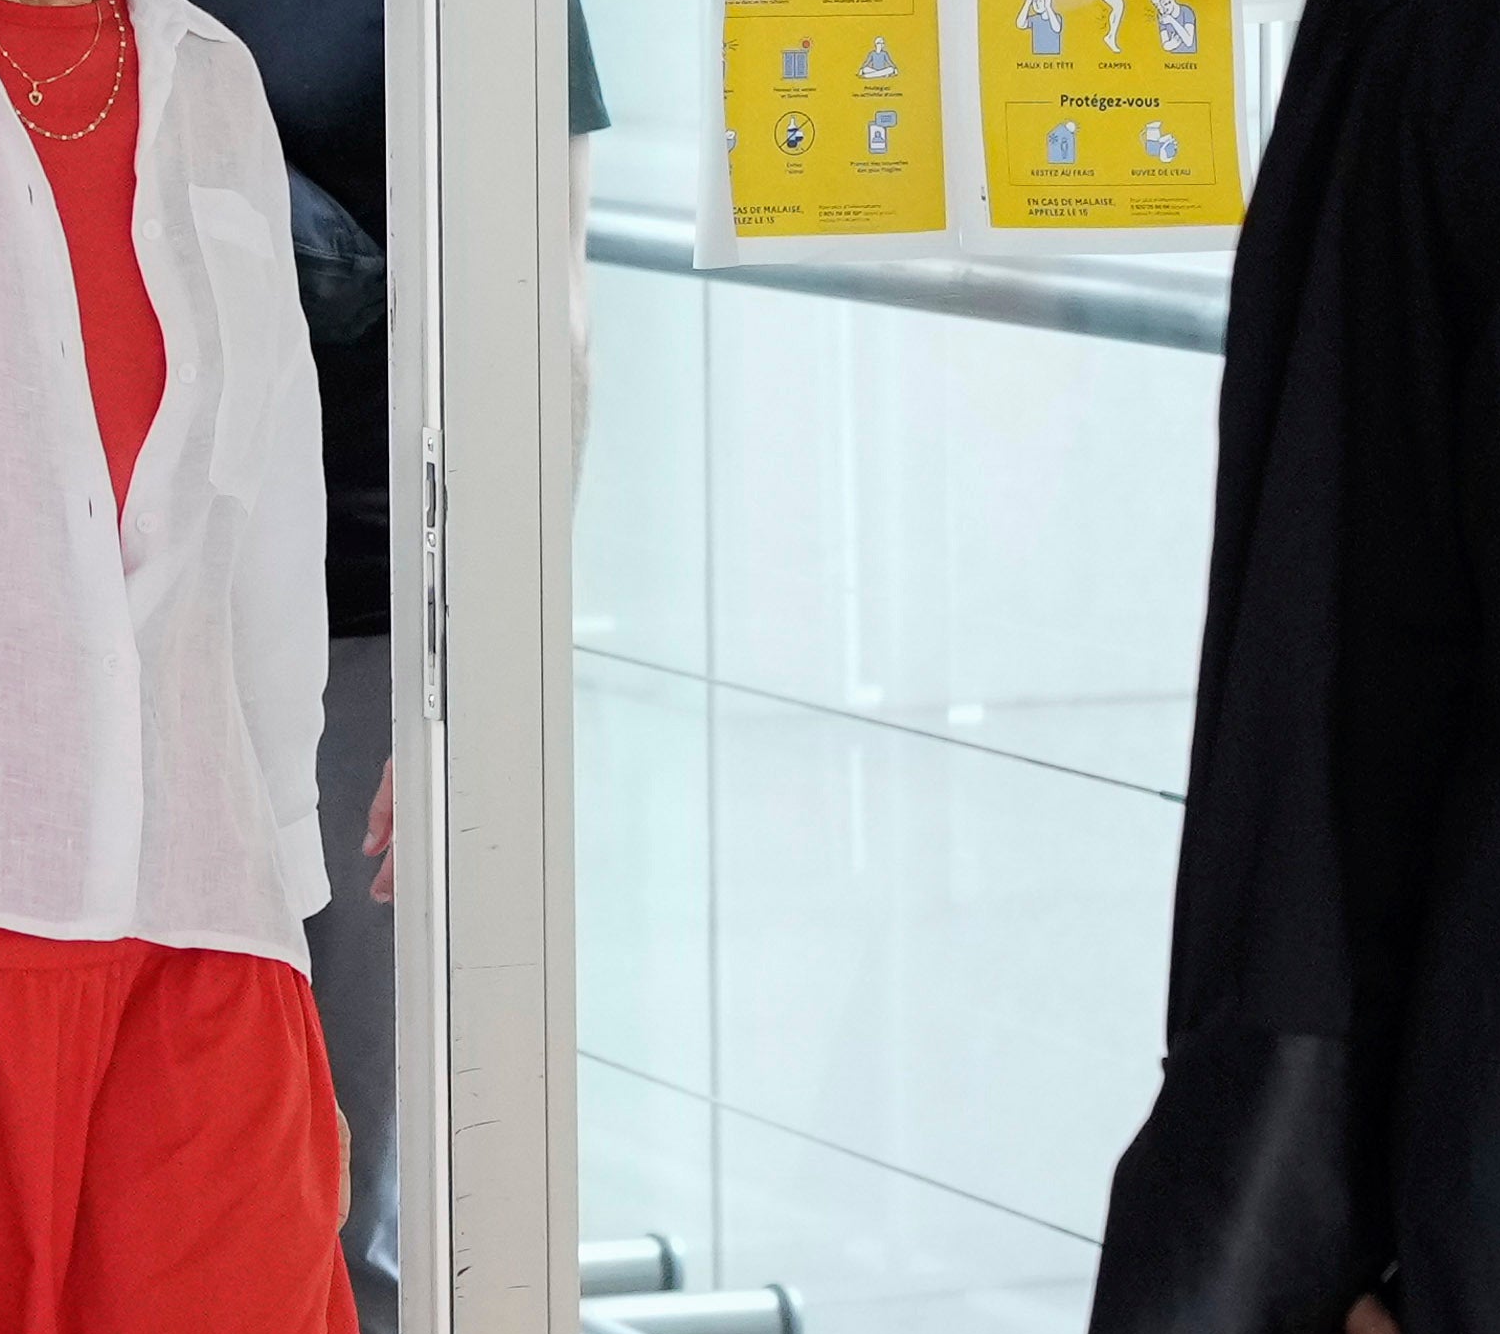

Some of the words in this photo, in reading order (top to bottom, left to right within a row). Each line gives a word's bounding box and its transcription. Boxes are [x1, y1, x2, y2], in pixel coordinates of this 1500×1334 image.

[1060, 94, 1160, 111] Protégez-vous
[1042, 198, 1059, 207] CAS
[1061, 199, 1074, 207] DE
[750, 206, 760, 215] DE
